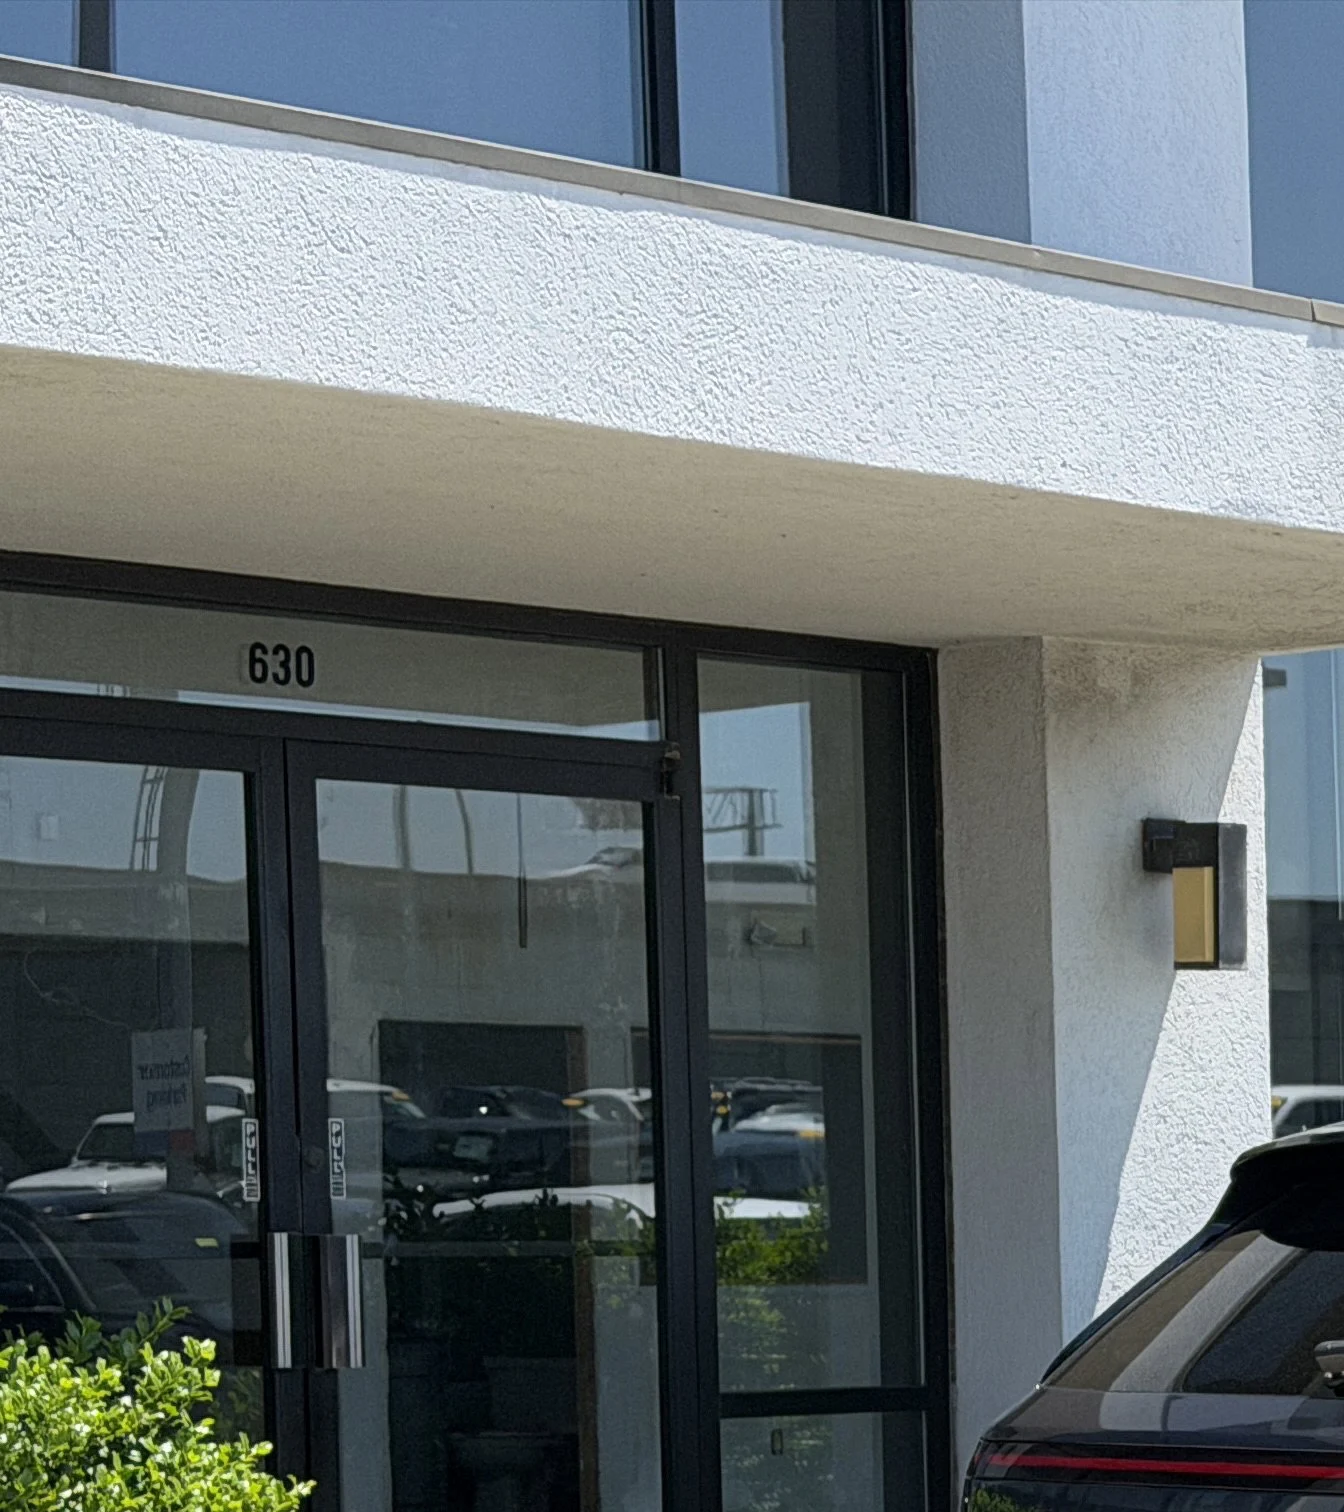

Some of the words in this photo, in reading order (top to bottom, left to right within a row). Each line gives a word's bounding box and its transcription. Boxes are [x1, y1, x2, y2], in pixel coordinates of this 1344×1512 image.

[248, 641, 315, 689] 630
[246, 1123, 256, 1174] PULL
[331, 1122, 342, 1173] PULL
